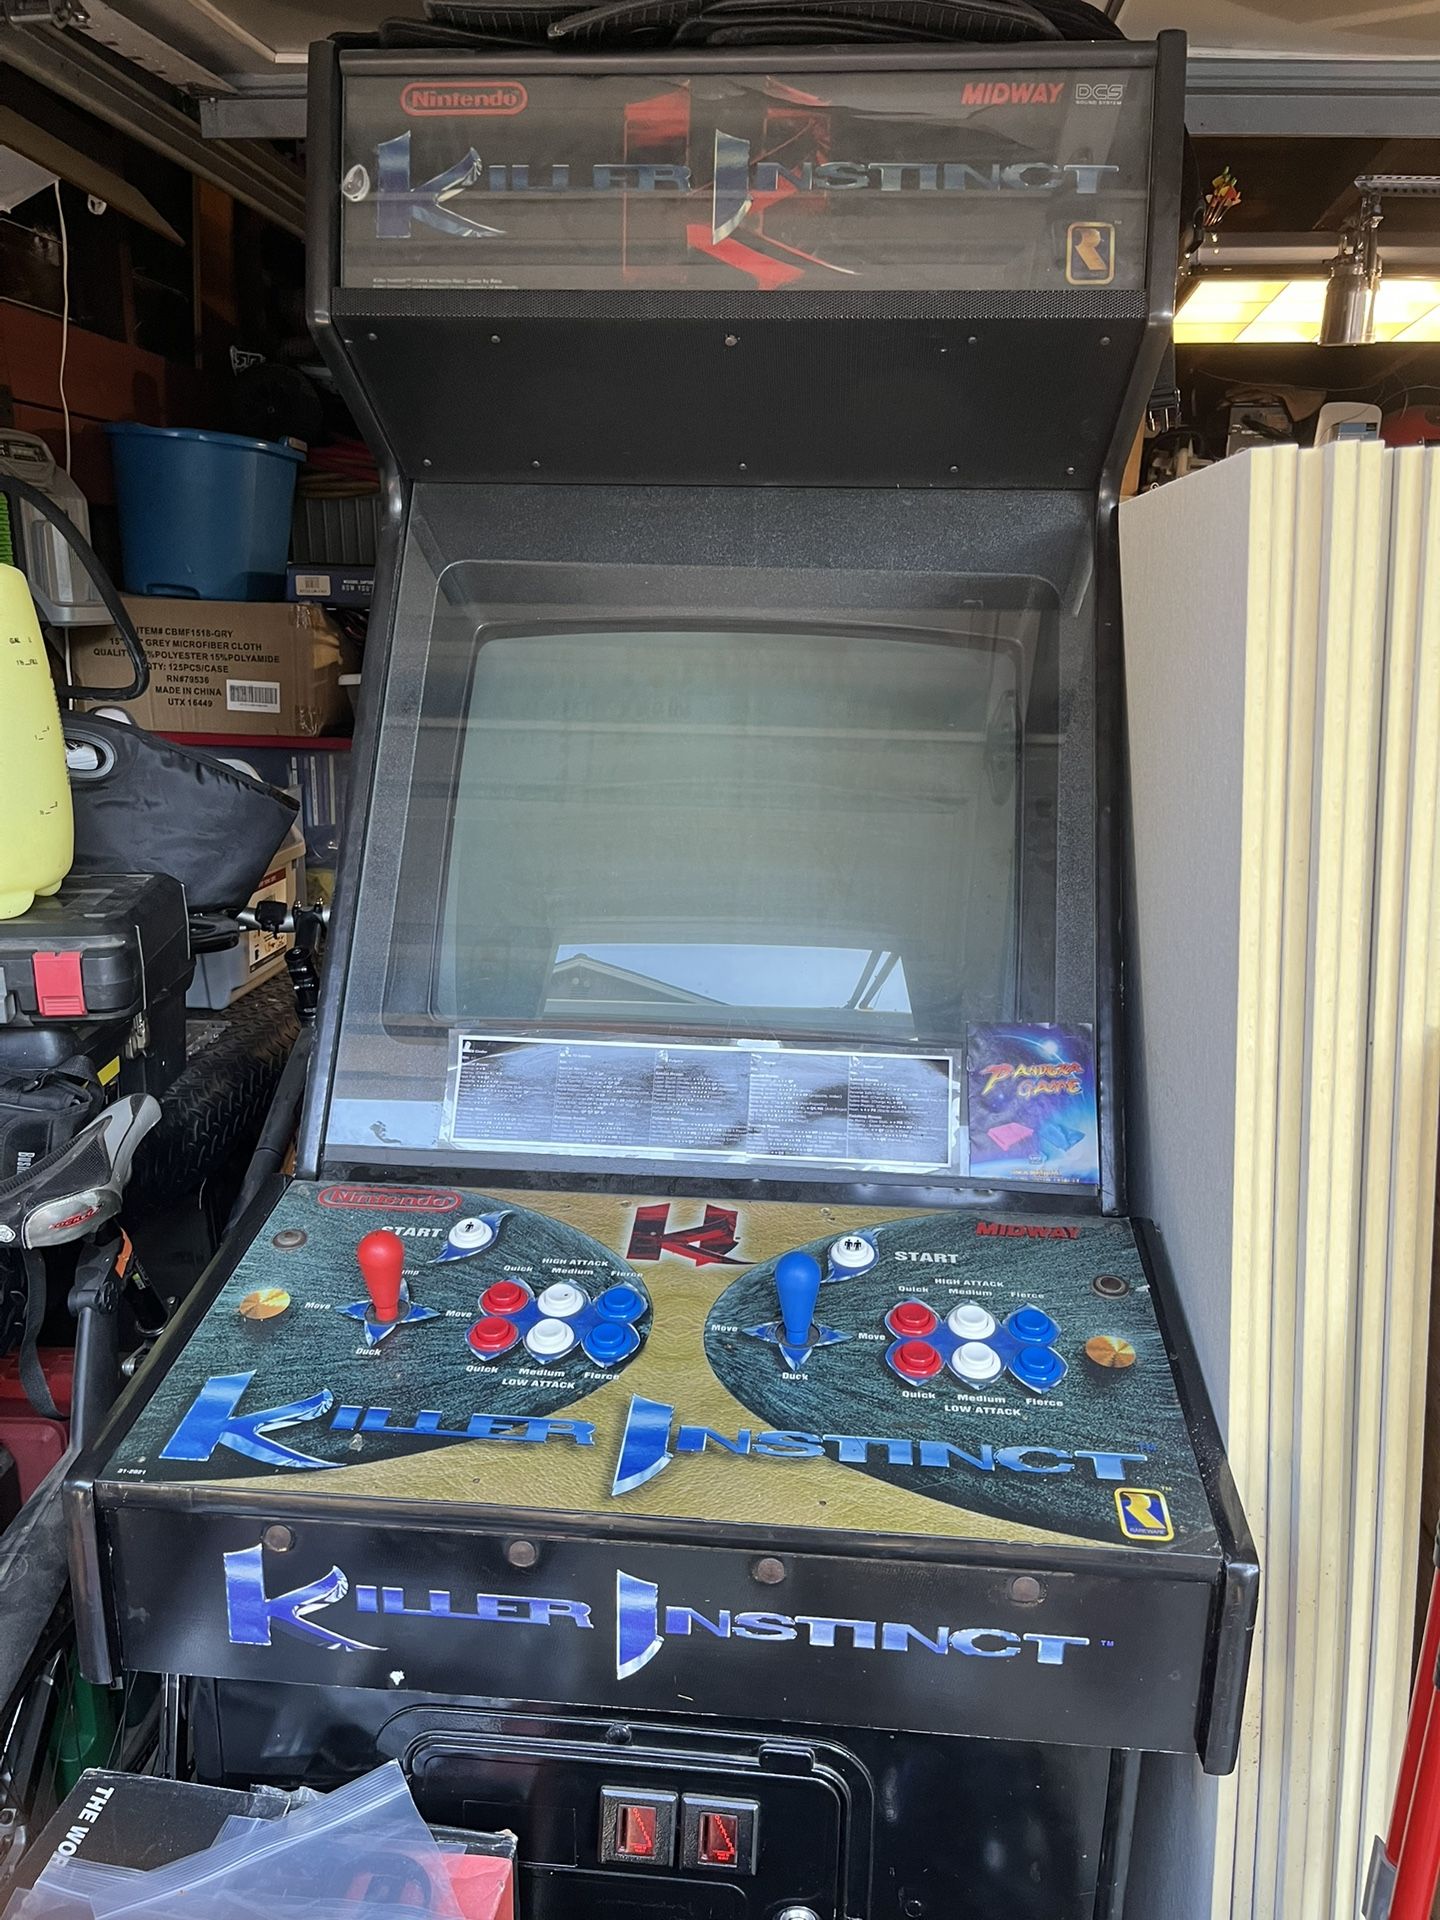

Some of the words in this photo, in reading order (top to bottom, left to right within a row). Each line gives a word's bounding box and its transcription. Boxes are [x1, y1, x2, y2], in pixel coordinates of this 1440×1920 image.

[961, 82, 1065, 105] MIDWAY
[1076, 84, 1123, 100] DCS
[412, 89, 517, 107] Nintendo
[376, 130, 691, 238] KILLER
[713, 129, 1119, 245] INSTINCT
[145, 639, 171, 647] GREY
[172, 640, 230, 650] MICROFIBER
[231, 642, 262, 651] CLOTH
[168, 663, 229, 673] 125PCS/CASE
[155, 686, 181, 695] MADE
[182, 687, 192, 695] IN
[193, 688, 222, 697] CHINA
[168, 698, 186, 707] UTX
[187, 699, 213, 708] 16449
[331, 1190, 450, 1207] Nintendo
[976, 1222, 1081, 1240] MIDWAY
[542, 1258, 567, 1266] HIGH
[569, 1259, 609, 1267] ATTACK
[895, 1251, 959, 1264] START
[503, 1264, 533, 1273] Quick
[552, 1267, 594, 1276] Medium
[935, 1277, 960, 1285] HIGH
[963, 1279, 1005, 1288] ATTACK
[898, 1285, 929, 1293] Quick
[948, 1288, 993, 1297] Medium
[305, 1302, 331, 1310] Move
[445, 1310, 473, 1318] Move
[711, 1324, 738, 1332] Move
[858, 1332, 886, 1341] Move
[356, 1348, 382, 1356] Duck
[466, 1364, 499, 1374] Quick
[518, 1368, 566, 1378] Medium
[584, 1371, 620, 1381] Fierce
[782, 1372, 809, 1381] Duck
[502, 1378, 528, 1387] LOW
[530, 1380, 576, 1390] ATTACK
[902, 1390, 936, 1399] Quick
[957, 1394, 1006, 1404] Medium
[1025, 1398, 1064, 1407] Fierce
[944, 1404, 972, 1413] LOW
[975, 1406, 1021, 1416] ATTACK
[159, 1369, 596, 1469] KILLER
[611, 1393, 1147, 1496] INSTINCT
[223, 1544, 594, 1652] KILLER
[617, 1569, 1089, 1680] INSTINCT
[77, 1786, 116, 1824] THE
